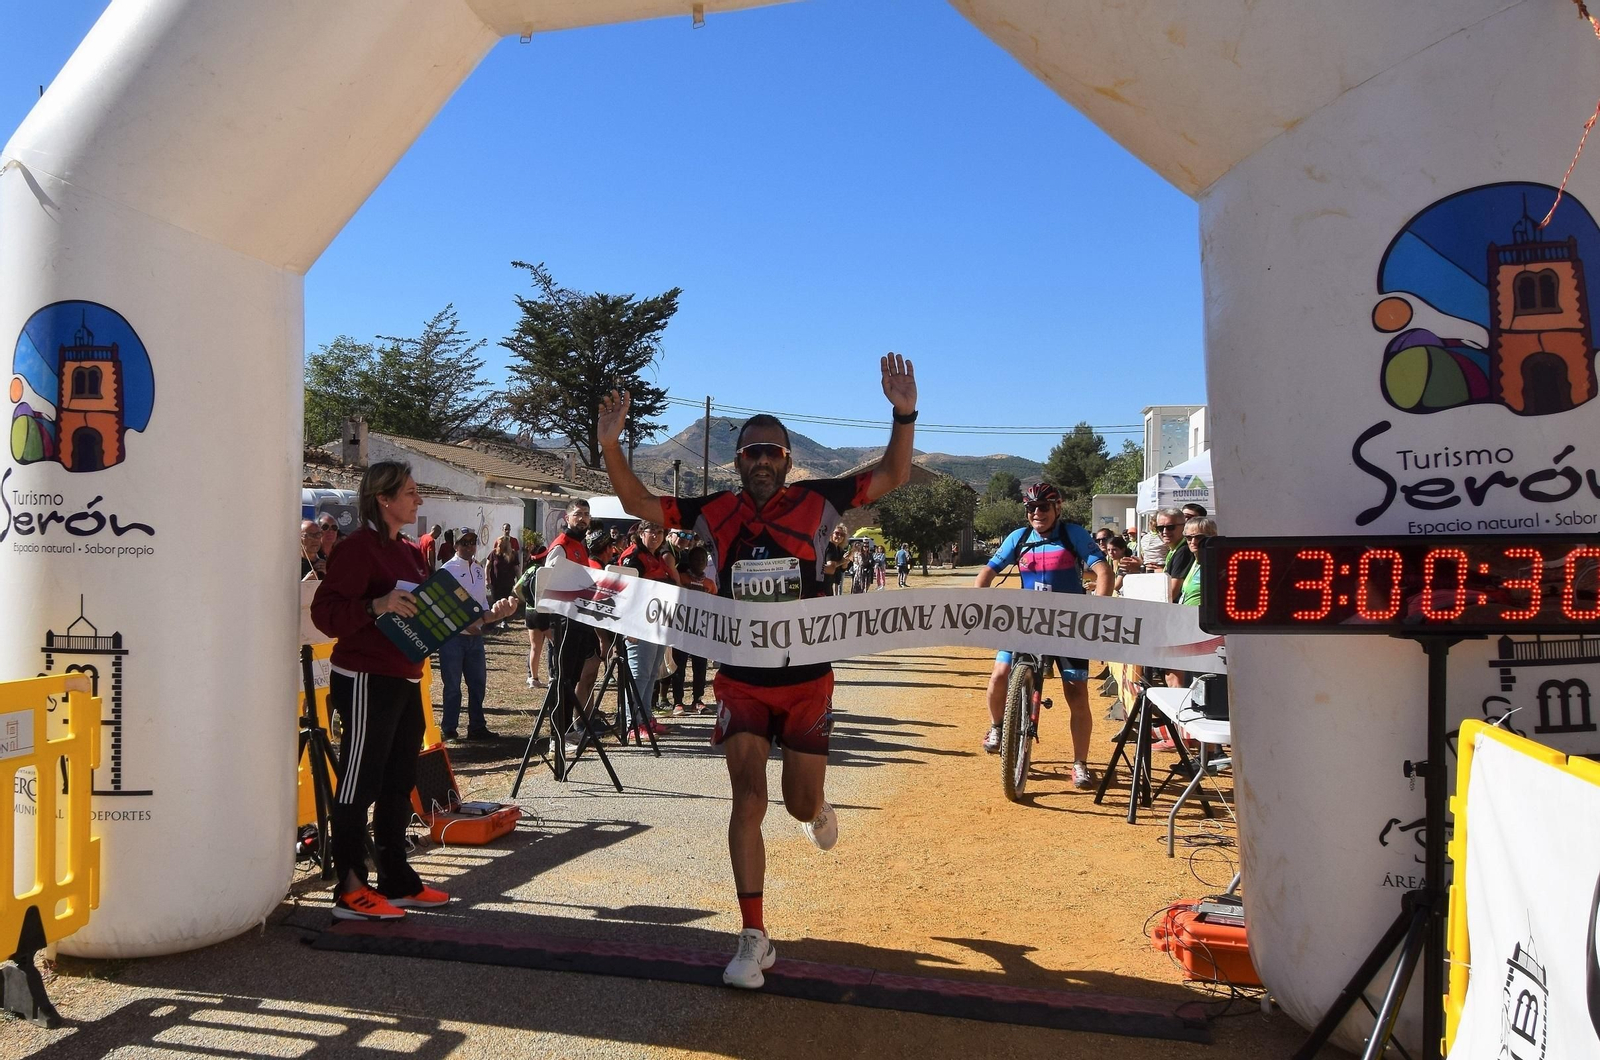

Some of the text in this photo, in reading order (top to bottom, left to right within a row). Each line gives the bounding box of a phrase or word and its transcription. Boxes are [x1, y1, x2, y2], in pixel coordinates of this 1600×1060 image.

[1396, 446, 1514, 471] Turismo
[1352, 420, 1600, 527] Seró
[13, 490, 64, 506] Turismo
[1173, 489, 1209, 498] RUNNING
[1408, 510, 1598, 535] Espacio natural Sabor
[13, 542, 155, 558] Espacio natural Sabor propio
[737, 574, 787, 596] 1001
[391, 614, 430, 654] zolafren
[645, 597, 1143, 649] FEDERACIÓN ANDALUZA DE ATLETISMO
[90, 810, 151, 821] DEPORTES
